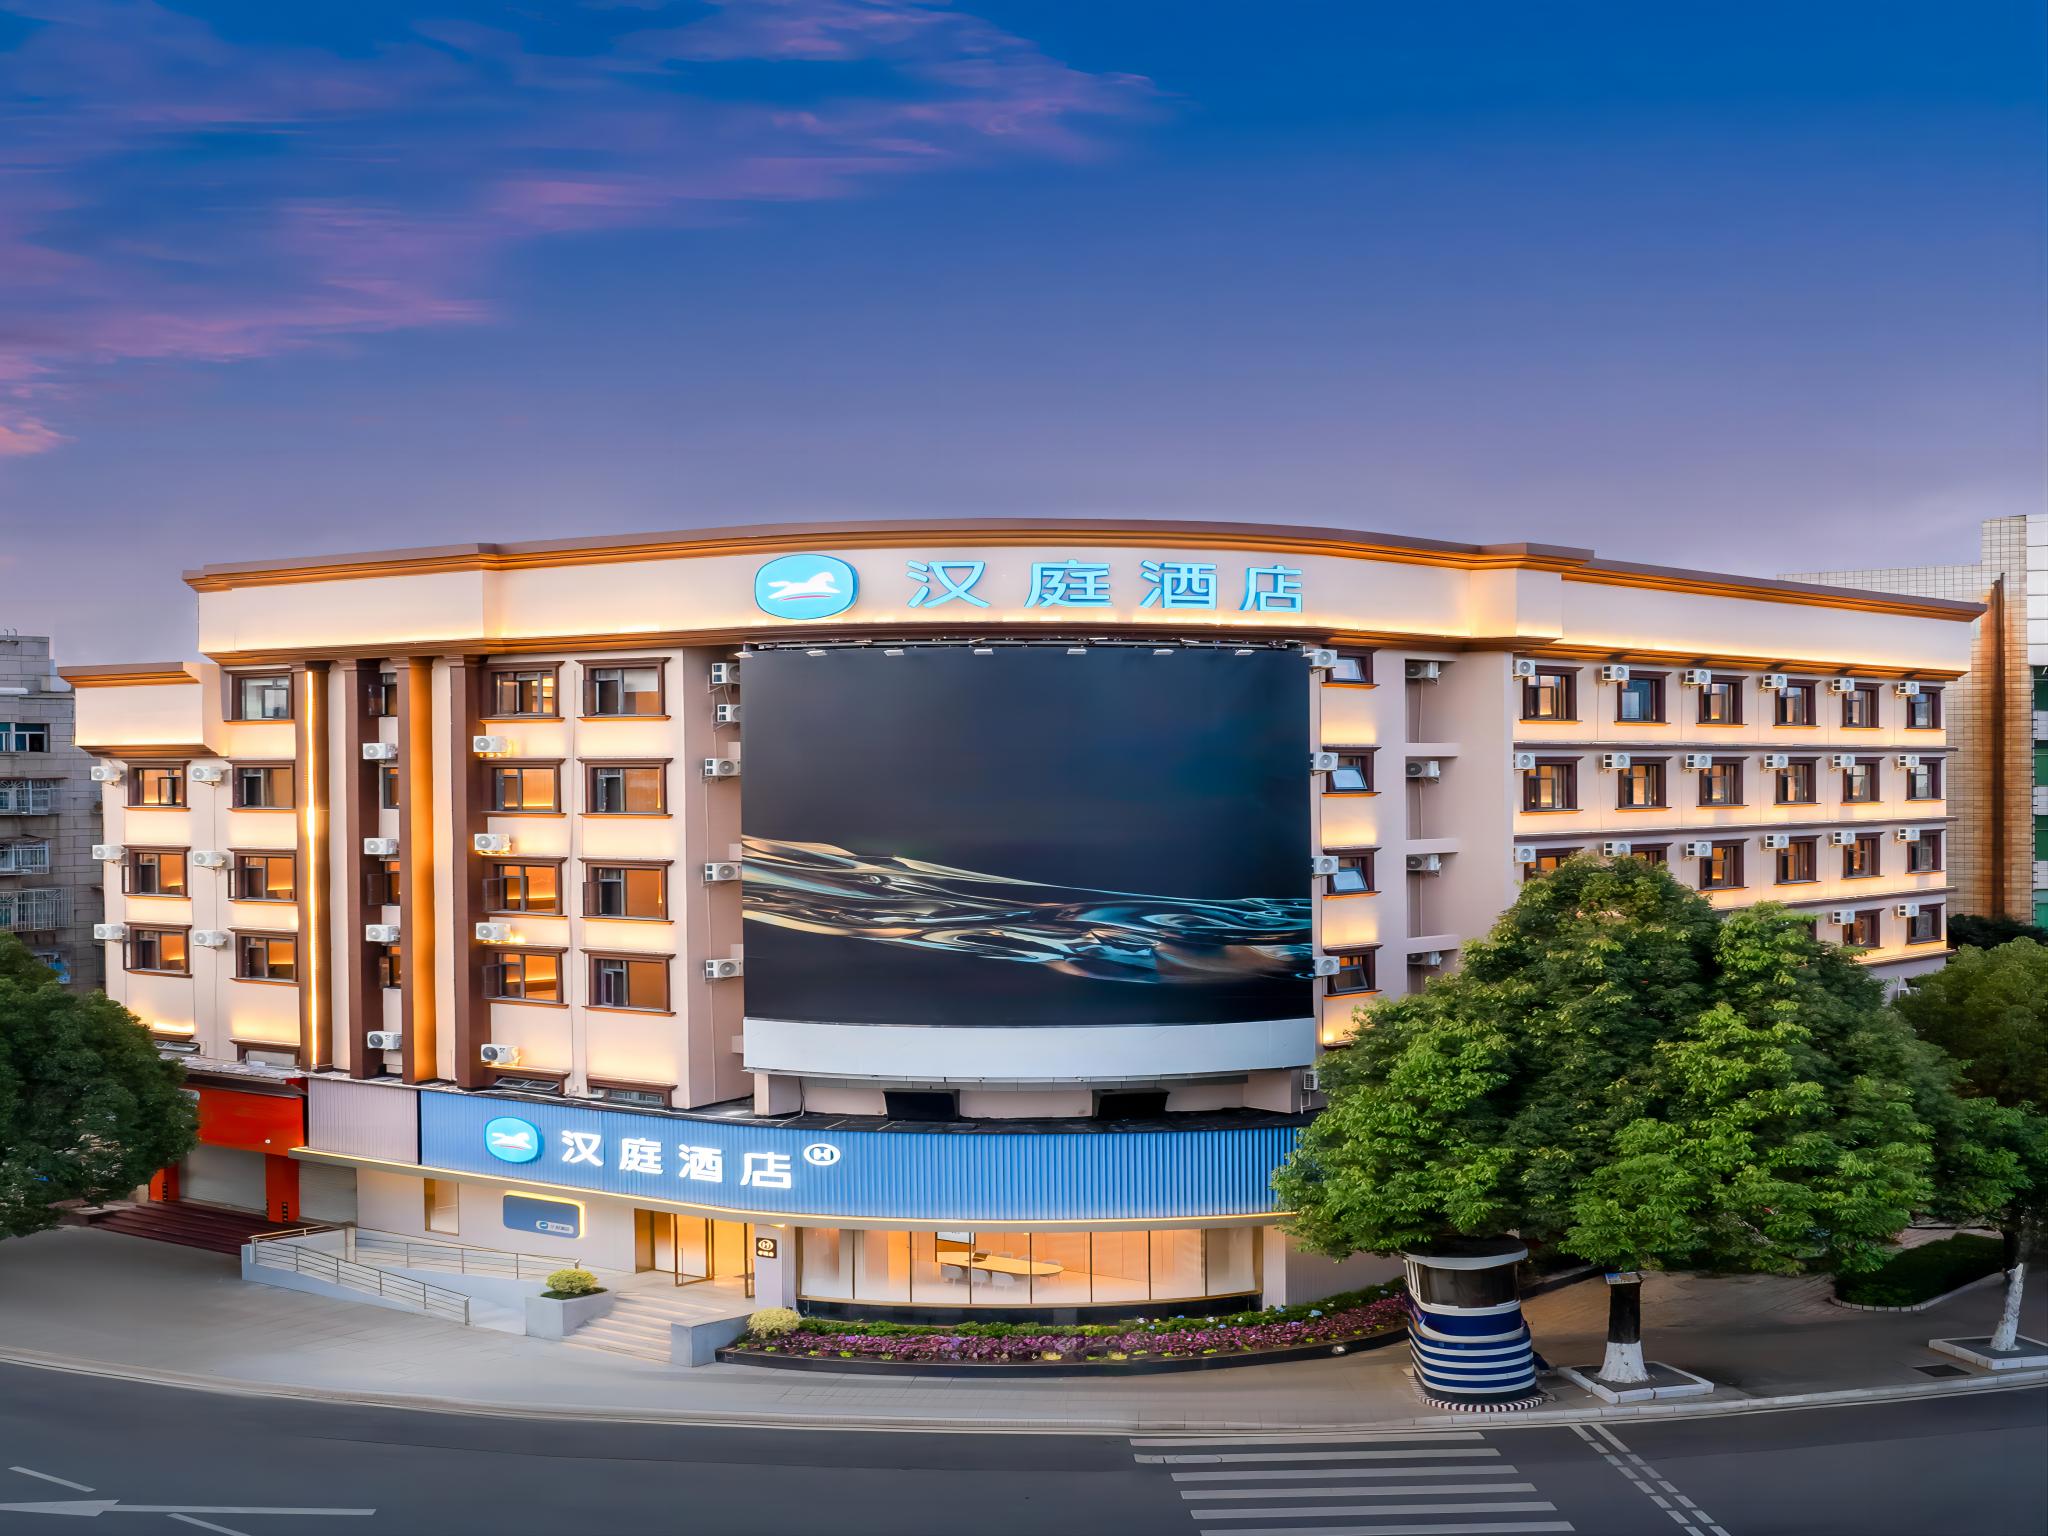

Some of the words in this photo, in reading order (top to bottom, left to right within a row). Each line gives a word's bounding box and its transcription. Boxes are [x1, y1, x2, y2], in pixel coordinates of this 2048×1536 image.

[906, 559, 1303, 613] 汉庭酒店
[560, 1129, 793, 1190] 汉庭酒店
